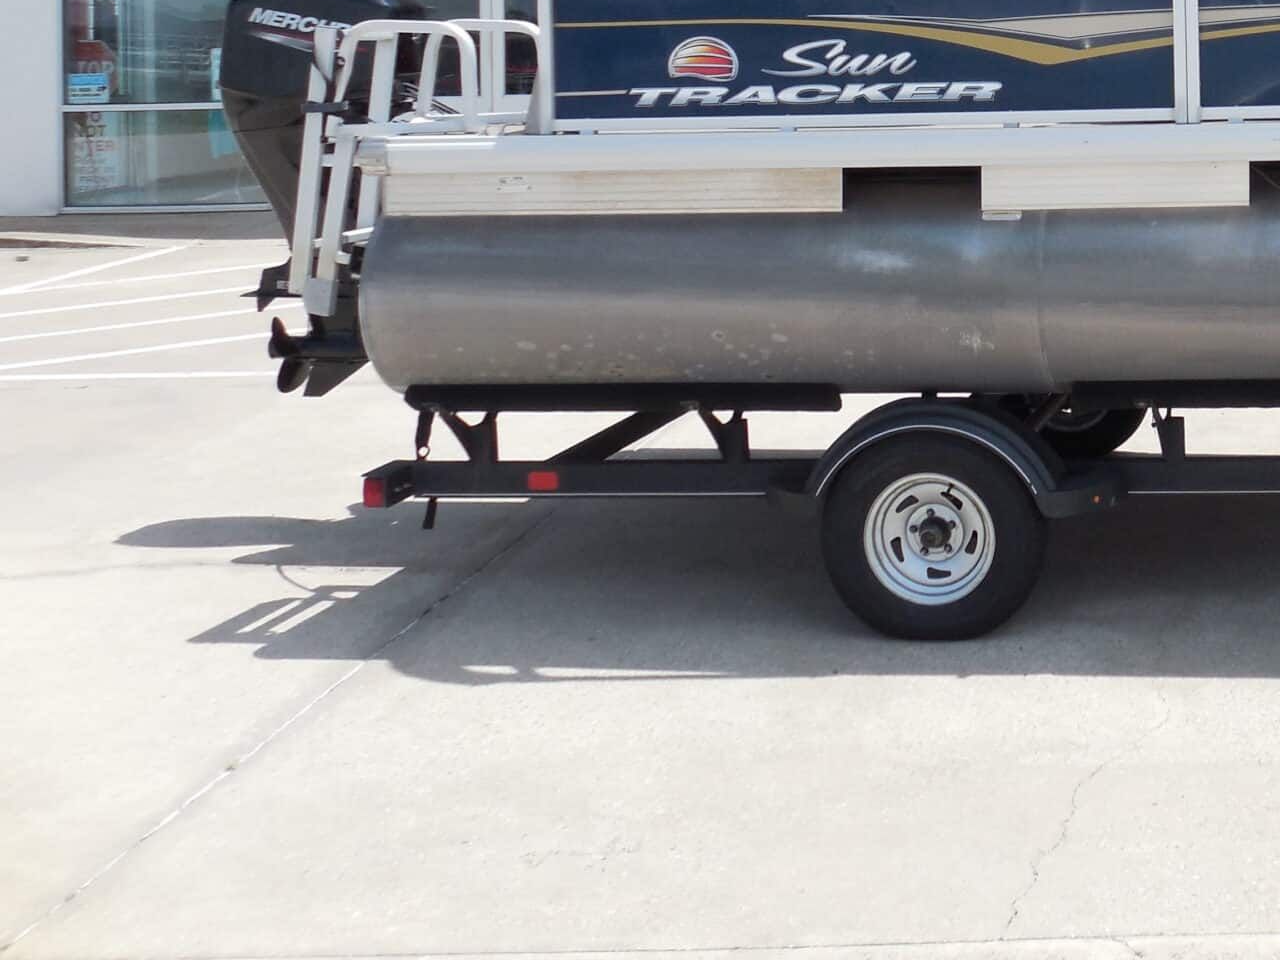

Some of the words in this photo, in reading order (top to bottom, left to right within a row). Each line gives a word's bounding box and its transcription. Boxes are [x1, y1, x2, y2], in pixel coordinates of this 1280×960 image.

[248, 7, 352, 33] MERC
[760, 39, 918, 77] Sun
[629, 81, 1003, 107] TRACKER
